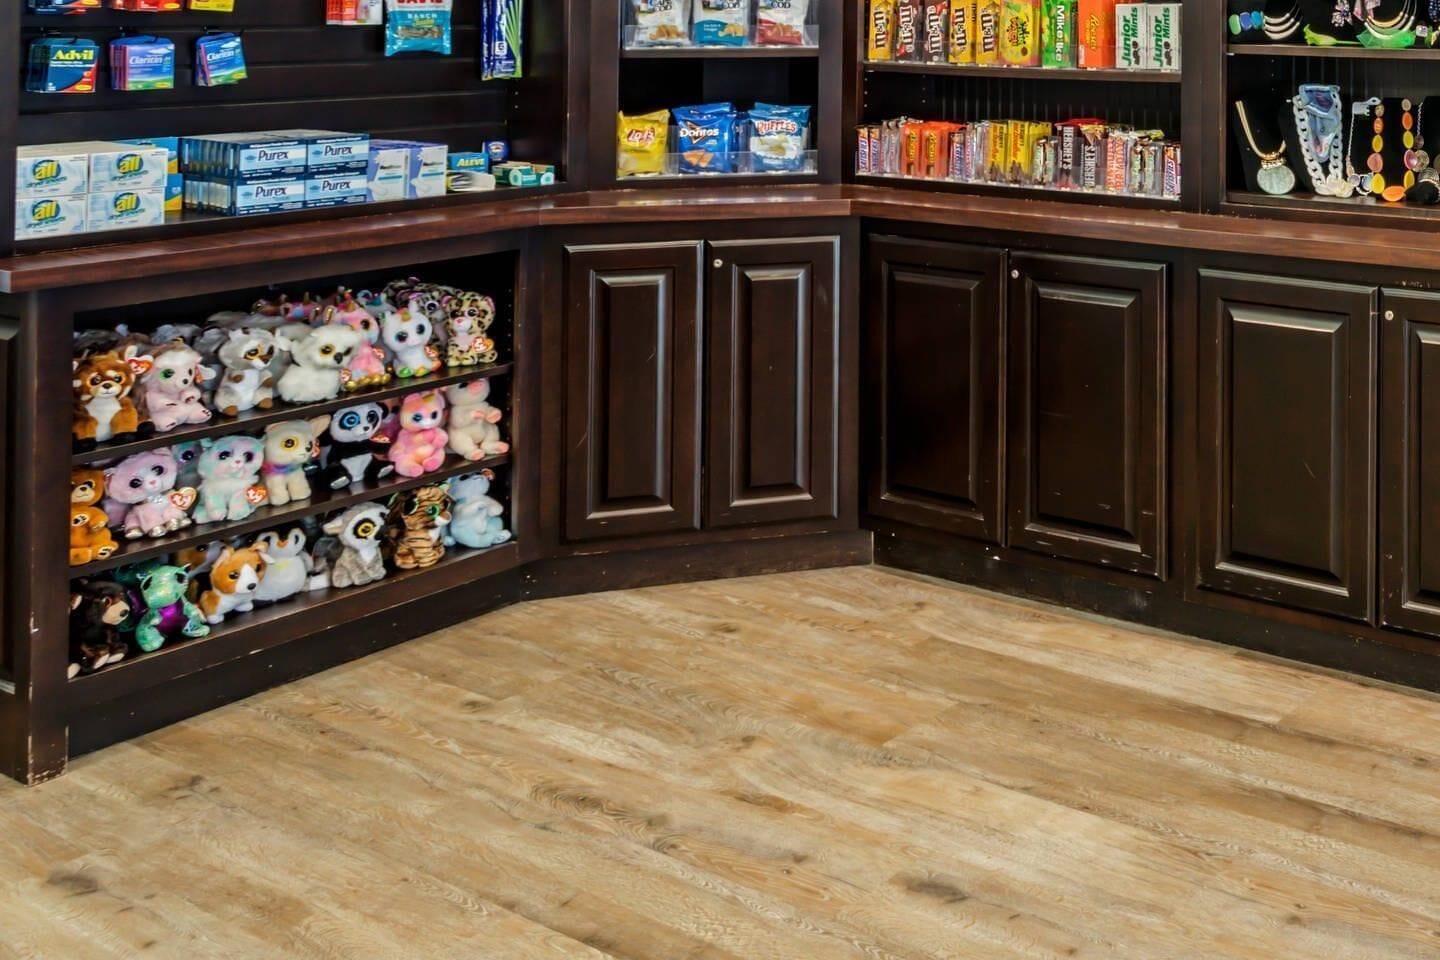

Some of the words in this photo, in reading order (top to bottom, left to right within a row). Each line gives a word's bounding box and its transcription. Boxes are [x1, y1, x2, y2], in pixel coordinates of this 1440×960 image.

[771, 1, 791, 9] COD
[1121, 16, 1131, 66] Junior
[1153, 16, 1163, 66] Junior
[53, 50, 94, 60] Advil
[129, 55, 163, 65] Claritin
[680, 126, 719, 138] Doritos
[755, 120, 796, 133] RUFFLES
[324, 145, 353, 156] Purex
[1063, 126, 1074, 170] HERSHEY'S
[257, 150, 289, 162] Purex
[456, 158, 485, 167] ALEVE
[34, 161, 58, 180] all
[119, 155, 142, 173] all
[1084, 145, 1096, 186] HERSHEY'S
[255, 186, 287, 199] Purex
[321, 181, 351, 192] Purex
[116, 194, 137, 212] all
[33, 201, 57, 220] all
[172, 494, 192, 509] ty
[249, 488, 266, 503] ty
